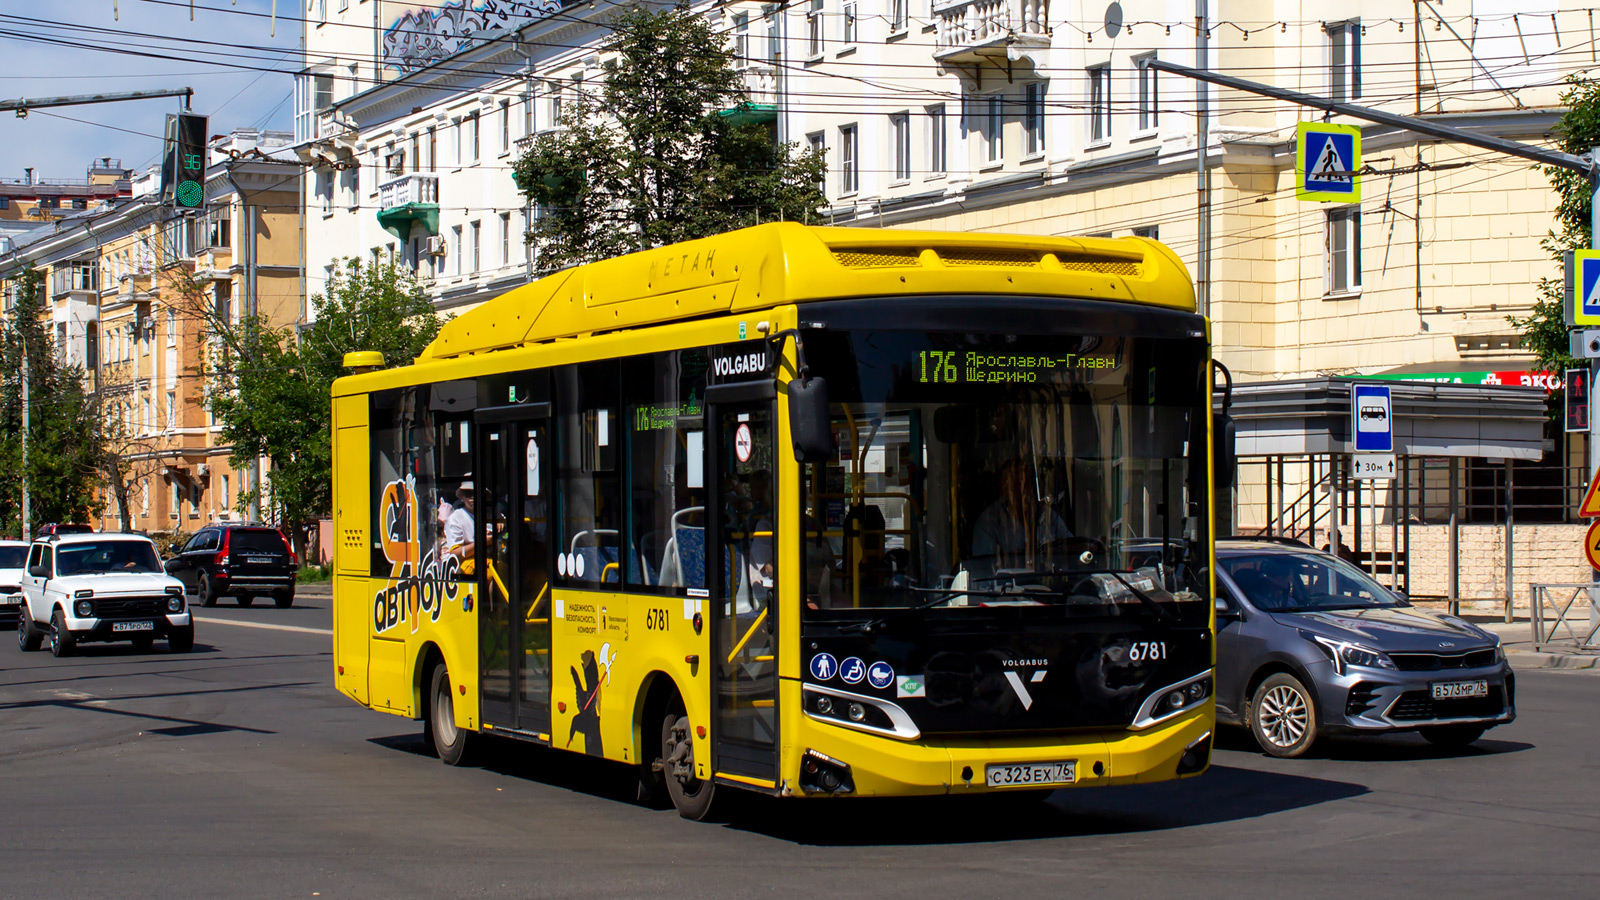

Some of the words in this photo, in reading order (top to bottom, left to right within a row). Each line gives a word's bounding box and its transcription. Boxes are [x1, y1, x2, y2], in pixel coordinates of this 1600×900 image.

[184, 153, 201, 170] 36
[648, 249, 716, 282] МЕТАН
[714, 352, 766, 376] VOLGABU
[920, 351, 957, 383] 176
[966, 351, 1115, 368] Ярославль-Главн
[966, 367, 1036, 383] Щедрино
[636, 407, 649, 431] 176
[374, 549, 460, 634] автобус
[565, 613, 596, 624] БЕЗОПАСНОСТЬ
[646, 608, 670, 631] 6781
[577, 626, 597, 635] КОМФОРТ
[1129, 641, 1167, 661] 6781
[1002, 659, 1048, 667] VOLGABUS
[1056, 763, 1070, 776] 76
